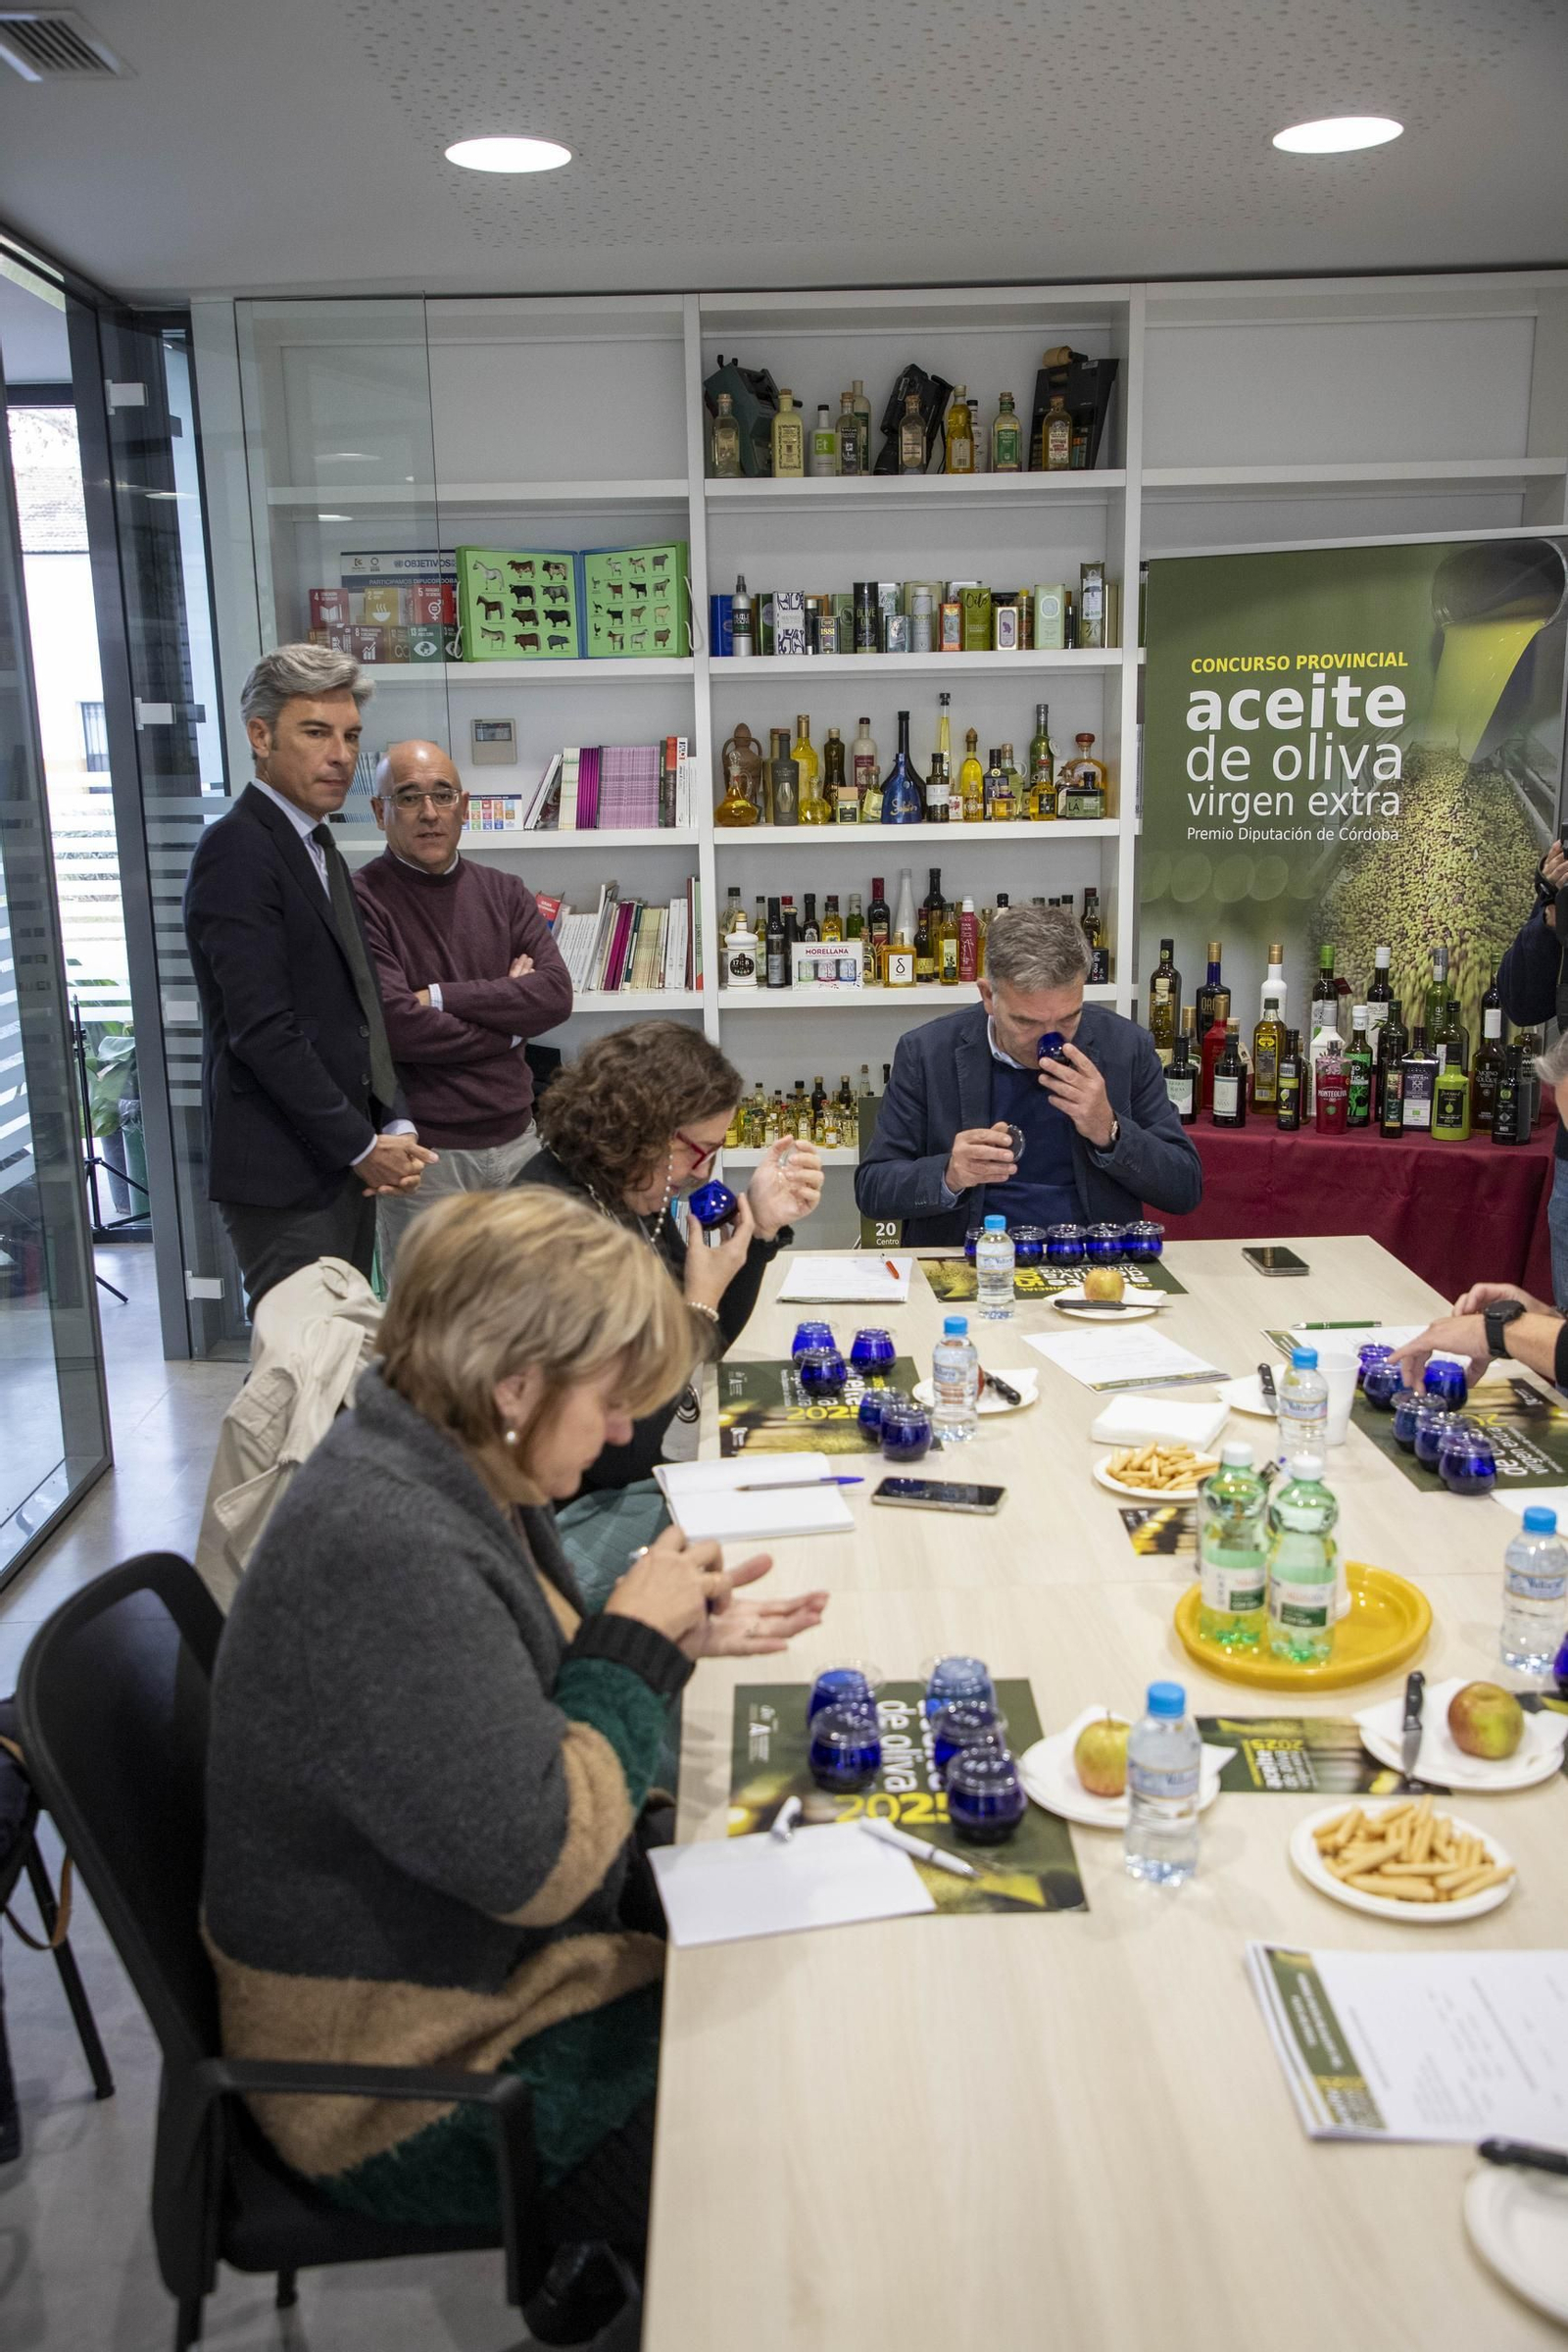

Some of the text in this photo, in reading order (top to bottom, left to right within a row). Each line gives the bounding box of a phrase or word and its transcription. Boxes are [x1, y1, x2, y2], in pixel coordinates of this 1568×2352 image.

[404, 559, 452, 568] OBJETIVOS
[1191, 652, 1408, 673] CONCURSO PROVINCIAL
[1186, 672, 1406, 731] aceite
[1186, 732, 1402, 782] de oliva
[1187, 785, 1399, 823] virgen extra
[1187, 826, 1399, 843] Premio Diputación de Córdoba
[875, 1222, 897, 1237] 20
[1042, 1270, 1086, 1280] liva
[1487, 1426, 1549, 1475] virgen extra
[877, 1699, 924, 1793] de oliva
